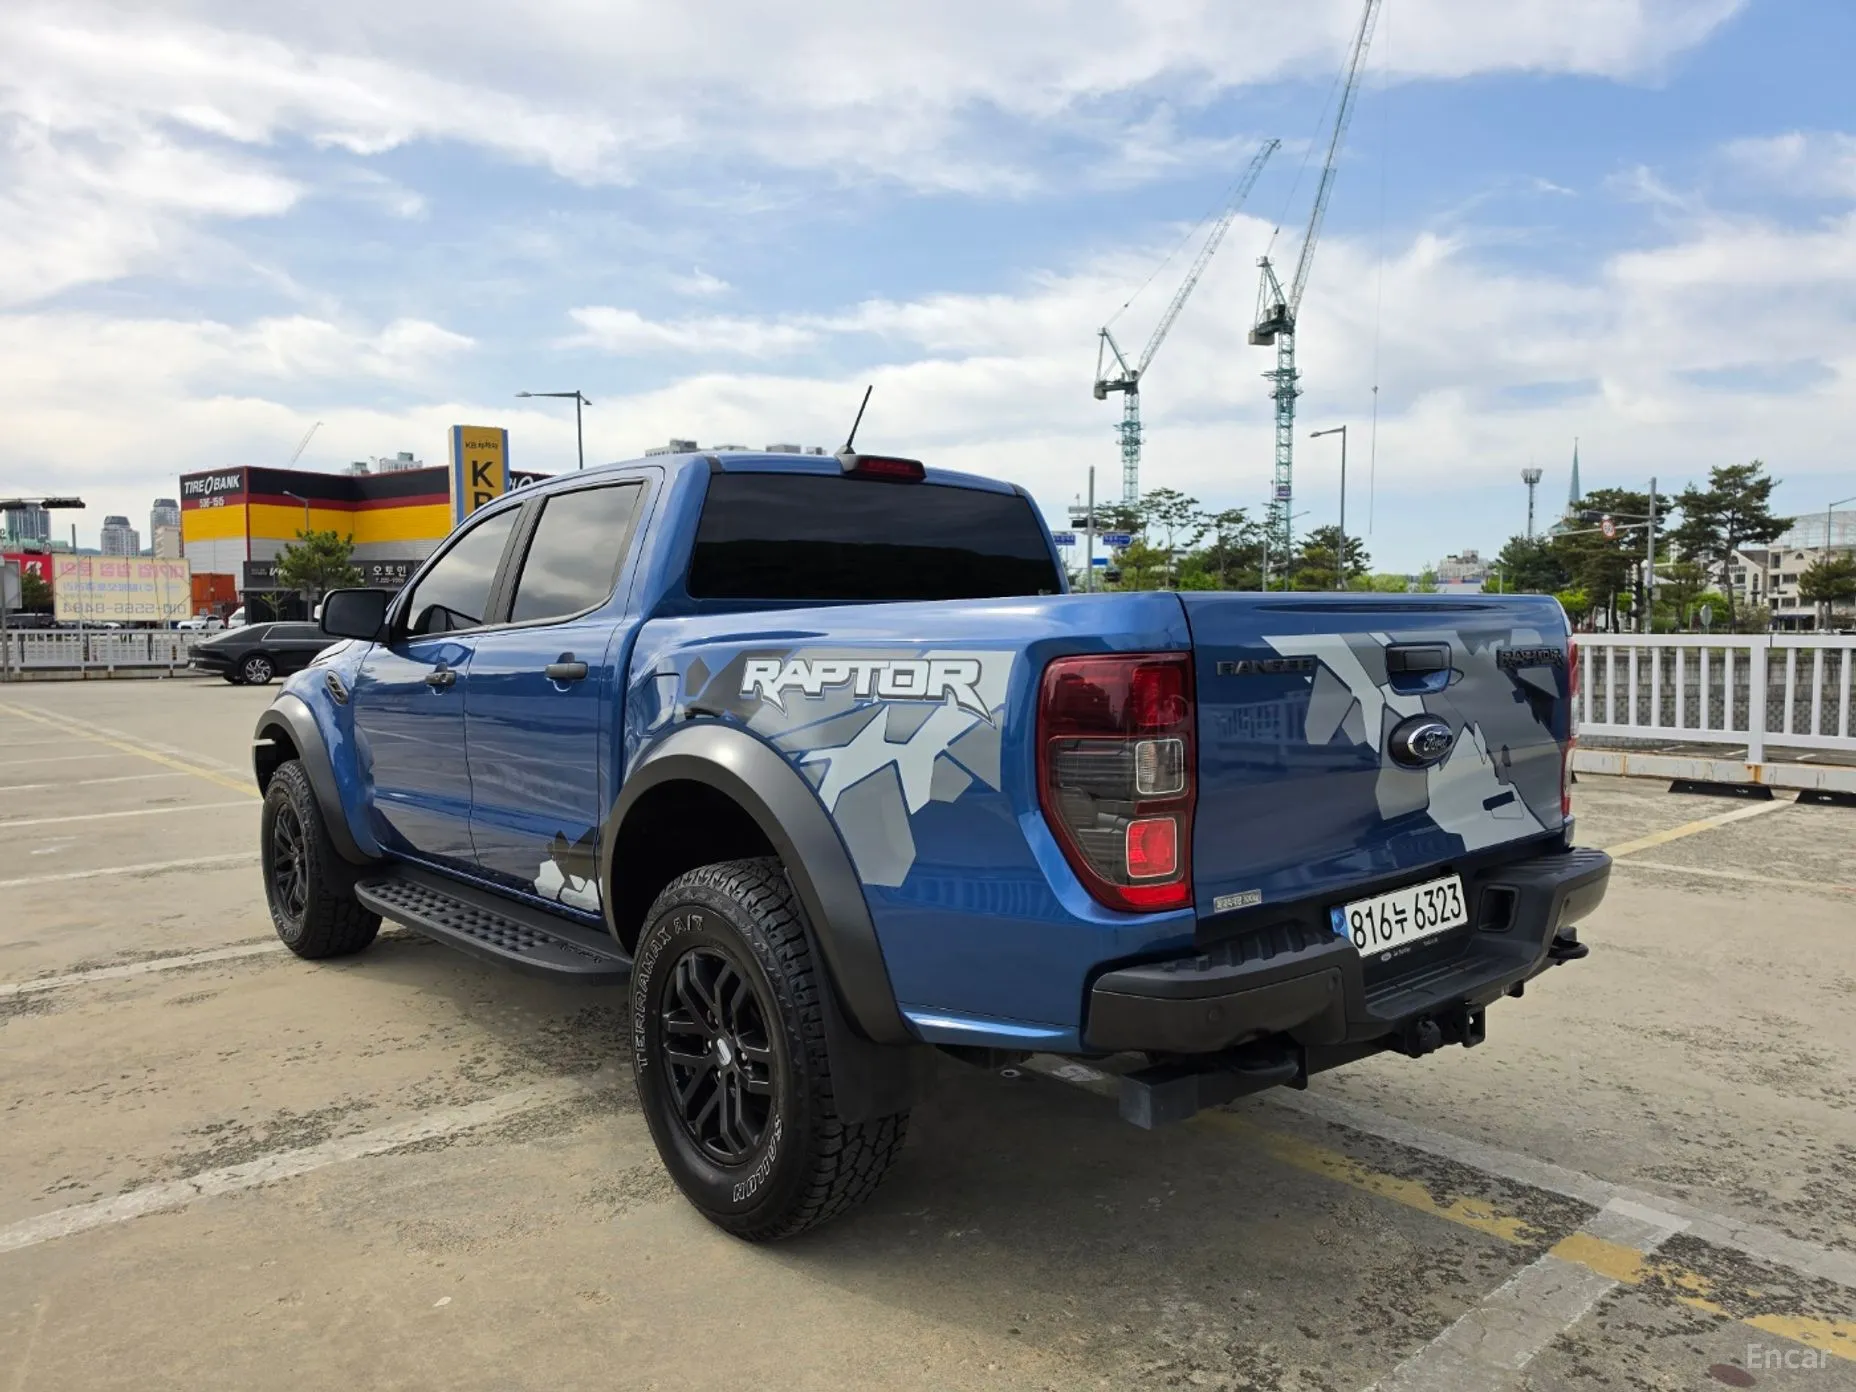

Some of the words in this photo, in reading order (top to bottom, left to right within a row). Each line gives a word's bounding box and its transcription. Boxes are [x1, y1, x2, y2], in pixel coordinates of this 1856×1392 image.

[1497, 648, 1564, 668] RAPTOR
[739, 658, 996, 729] RAPTOR
[1423, 730, 1449, 752] Ford
[1414, 883, 1461, 930] 6323
[635, 926, 672, 1073] TERRAMAX
